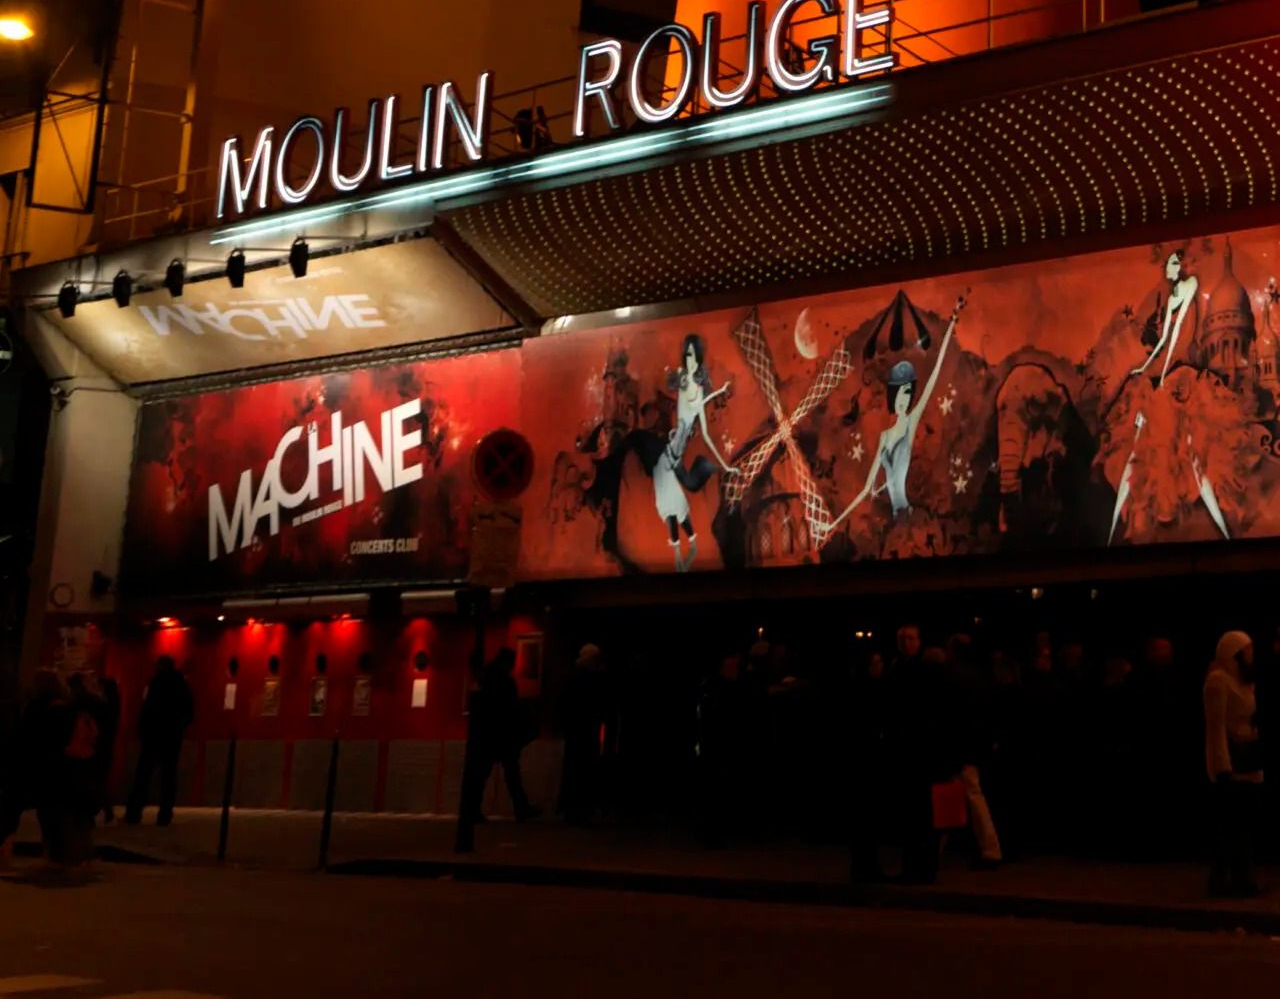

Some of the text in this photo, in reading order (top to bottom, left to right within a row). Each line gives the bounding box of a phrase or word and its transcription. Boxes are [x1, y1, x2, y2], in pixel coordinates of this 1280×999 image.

[215, 68, 495, 221] MOULIN
[208, 398, 424, 562] MACHINE
[350, 537, 419, 556] CONCERTS CLUB
